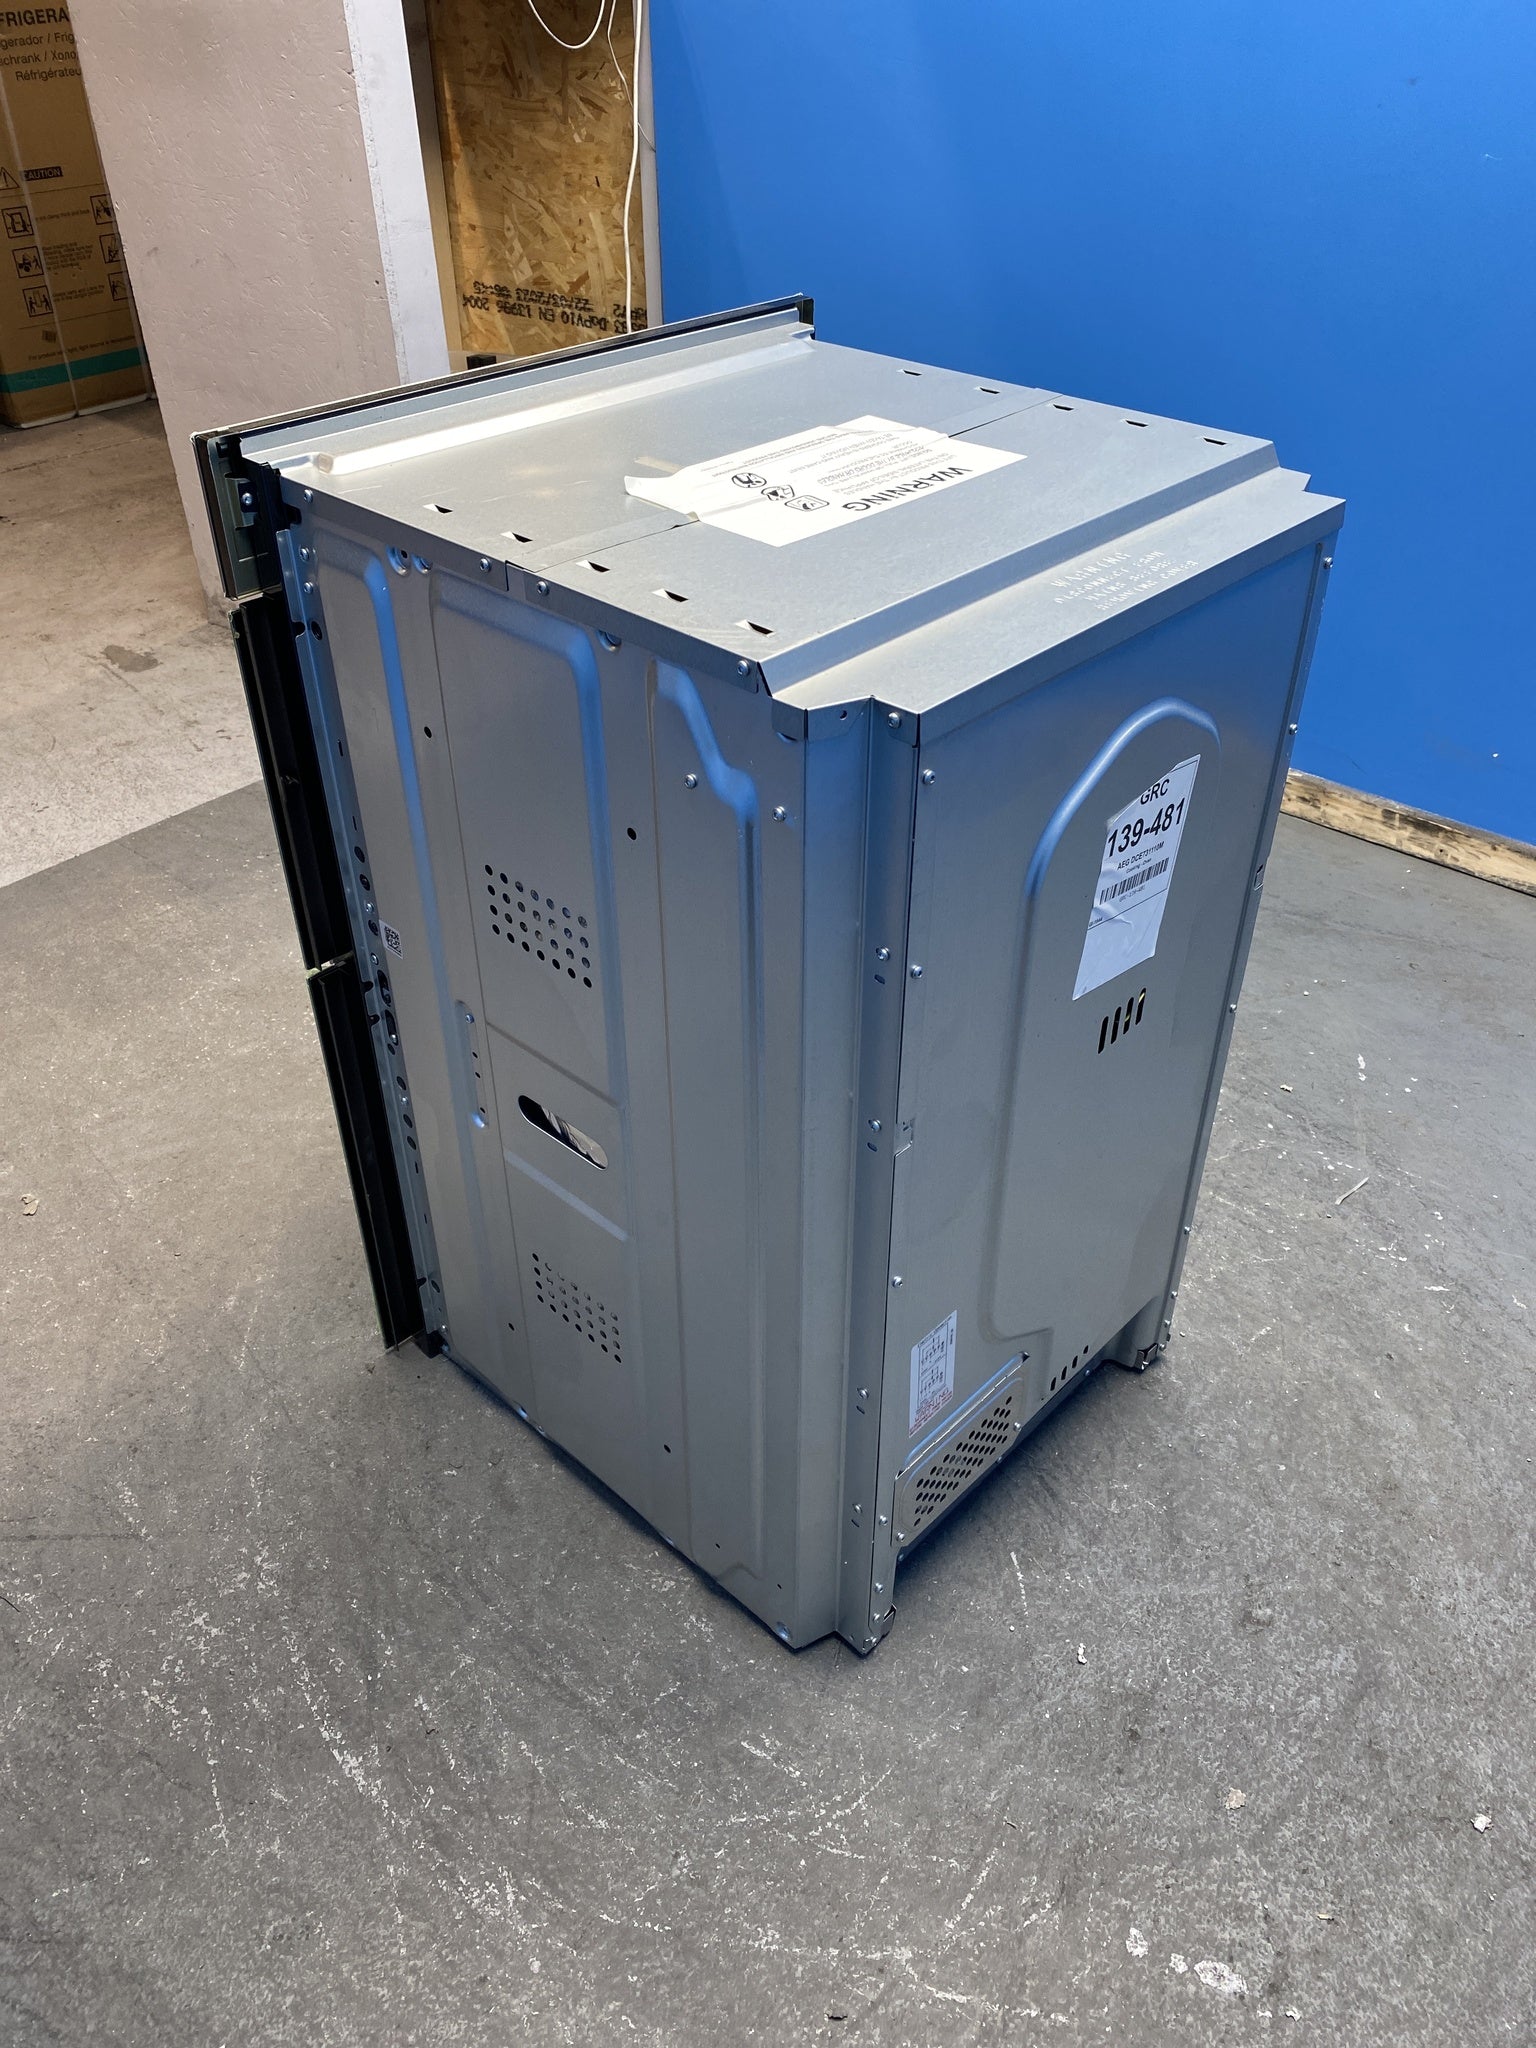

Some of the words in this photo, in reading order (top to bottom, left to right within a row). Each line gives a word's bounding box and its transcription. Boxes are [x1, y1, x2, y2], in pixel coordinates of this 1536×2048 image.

[24, 169, 62, 180] CAUTION
[842, 467, 973, 511] WARNING
[1140, 779, 1170, 805] GRC
[1108, 797, 1186, 858] 139-481
[1117, 859, 1130, 871] AEG
